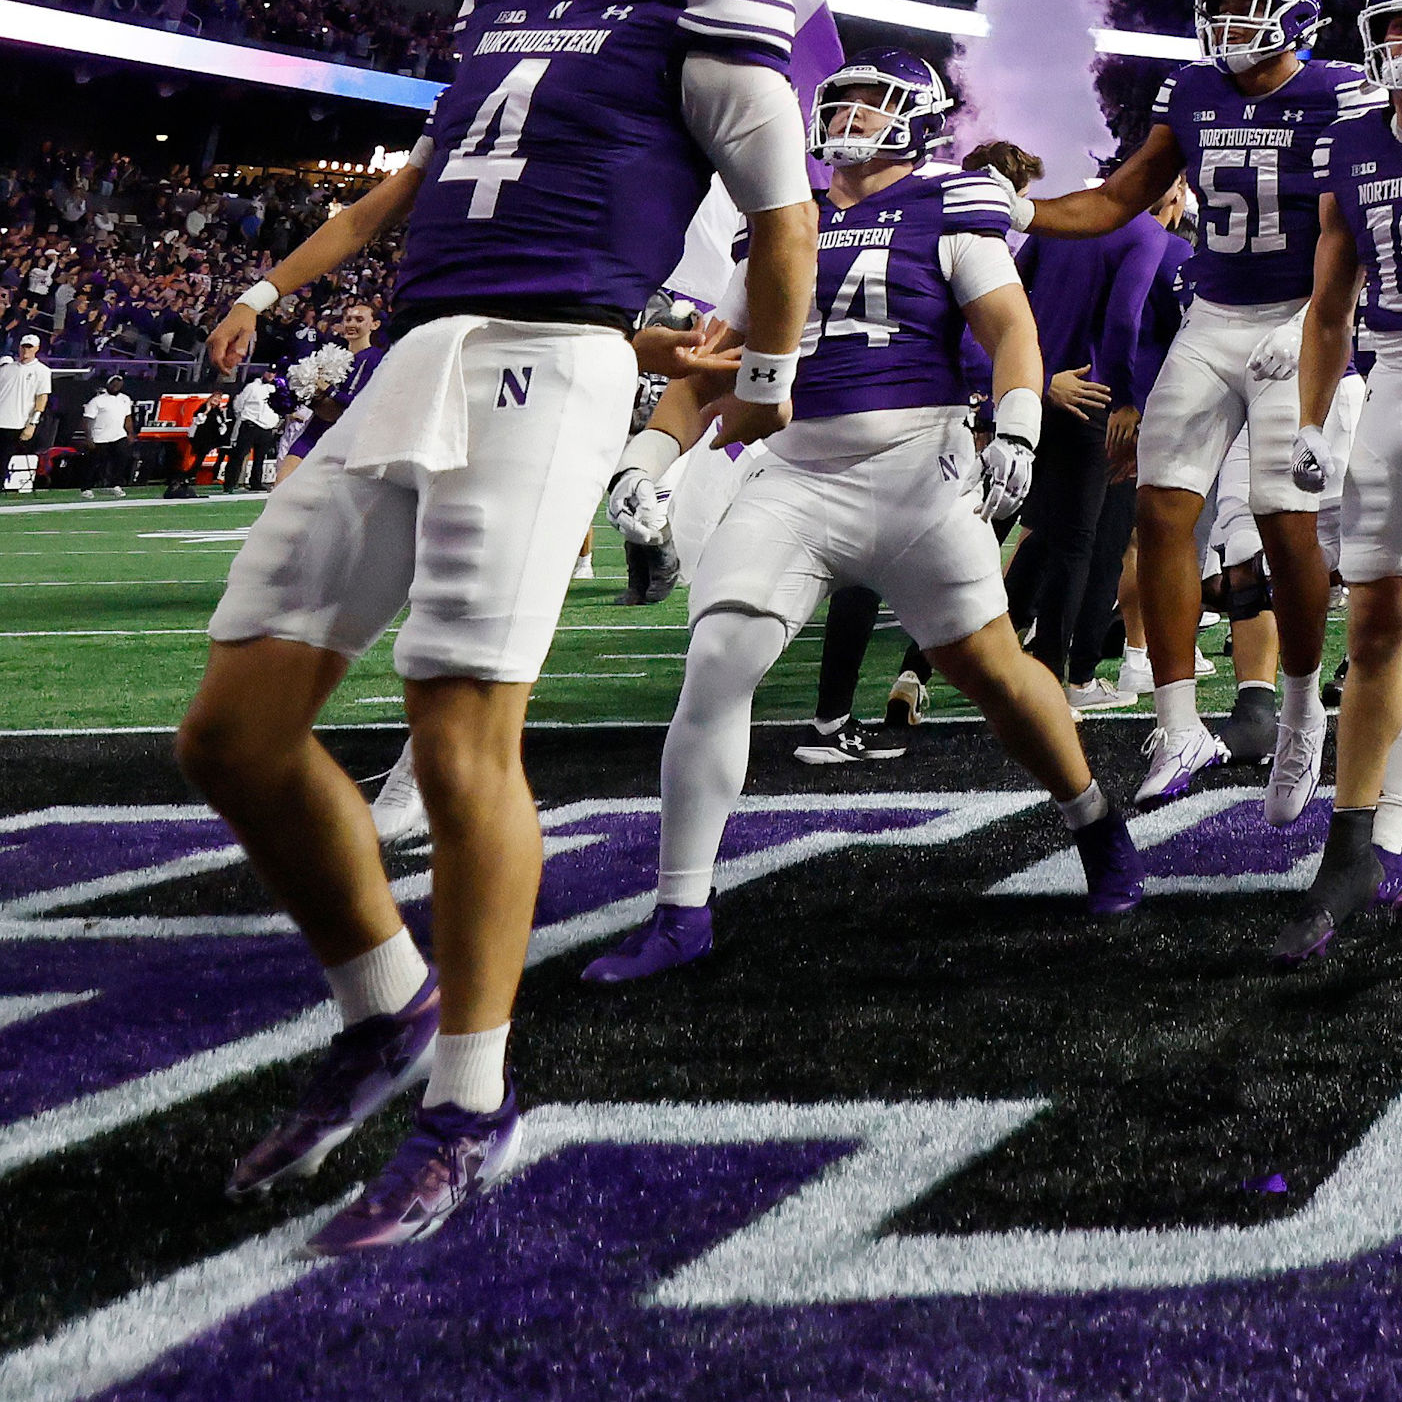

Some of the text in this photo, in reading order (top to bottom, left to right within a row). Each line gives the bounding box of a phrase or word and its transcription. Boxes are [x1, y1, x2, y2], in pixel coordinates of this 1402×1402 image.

[548, 0, 573, 19] N
[473, 29, 612, 56] NORTHWESTERN
[1243, 104, 1256, 120] N
[438, 58, 552, 219] 4
[1199, 128, 1294, 148] NORTHWESTERN
[1199, 149, 1287, 254] 51
[831, 209, 846, 224] N
[800, 248, 900, 358] 4
[493, 364, 537, 411] N
[937, 454, 960, 482] N
